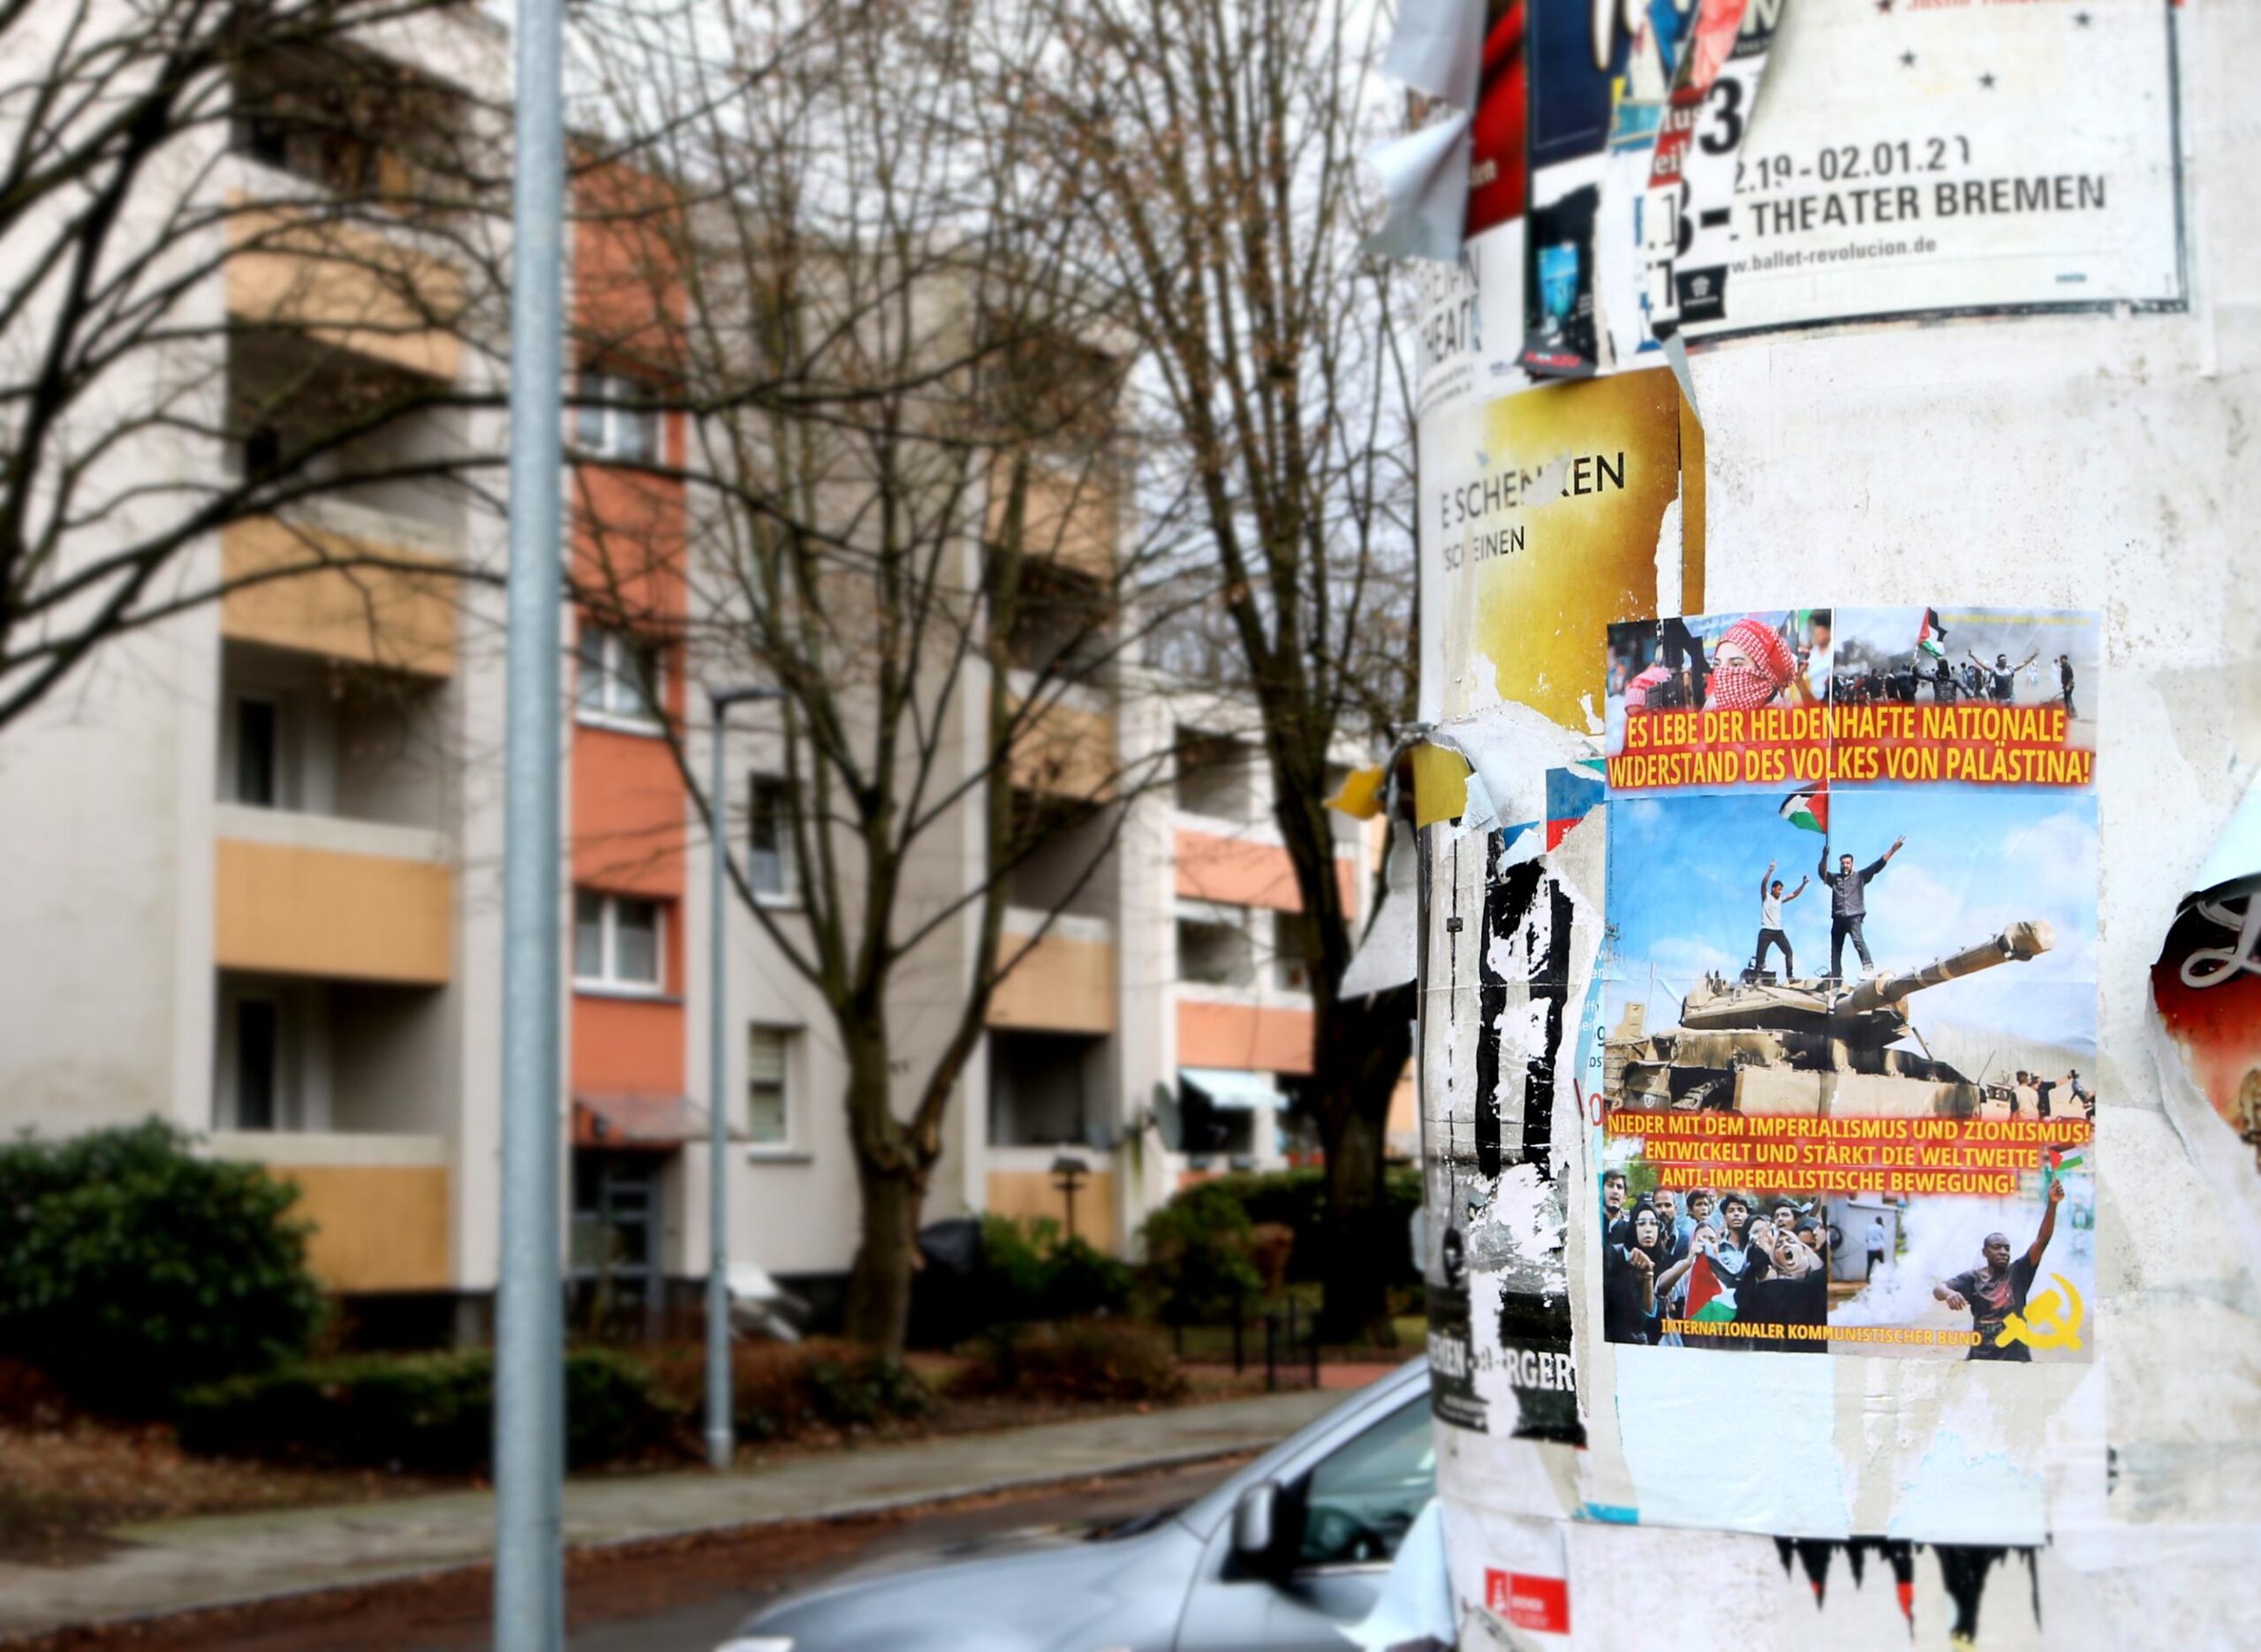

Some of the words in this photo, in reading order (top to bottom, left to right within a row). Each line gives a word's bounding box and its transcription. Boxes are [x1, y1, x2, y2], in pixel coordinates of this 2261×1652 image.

[1749, 185, 1920, 238] THEATER
[1934, 174, 2106, 218] BREMEN
[1628, 715, 1648, 748] ES
[1653, 713, 1698, 746] LEBE
[1705, 711, 1745, 743] DER
[1751, 706, 1915, 742] HELDENHAFTE
[1922, 707, 2064, 742] NATIONALE
[1608, 751, 1739, 788] WIDERSTAND
[1745, 748, 1786, 781] DES
[1791, 747, 1879, 781] VOLKES
[1886, 747, 1940, 780] VON
[1946, 740, 2091, 783] PALÄSTINA!
[1607, 1114, 1665, 1135] NIEDER
[1669, 1115, 1701, 1135] MIT
[1705, 1116, 1743, 1135] DEM
[1749, 1118, 1908, 1139] IMPERIALISMUS
[1912, 1120, 1958, 1140] UND
[1963, 1121, 2091, 1143] ZIONISMUS!
[1645, 1141, 1752, 1162] ENTWICKELT
[1756, 1143, 1798, 1164] UND
[1803, 1141, 1876, 1165] STÄRKT
[1881, 1146, 1916, 1165] DIE
[1919, 1148, 2038, 1168] WELTWEITE
[1661, 1167, 1885, 1190] ANTI-IMPERIALISTISCHE
[1890, 1173, 2016, 1194] BEWEGUNG!
[1660, 1318, 1784, 1339] INTERNATIONALER
[1788, 1324, 1934, 1345] KOMMUNISTISCHER
[1937, 1331, 1983, 1347] BUND
